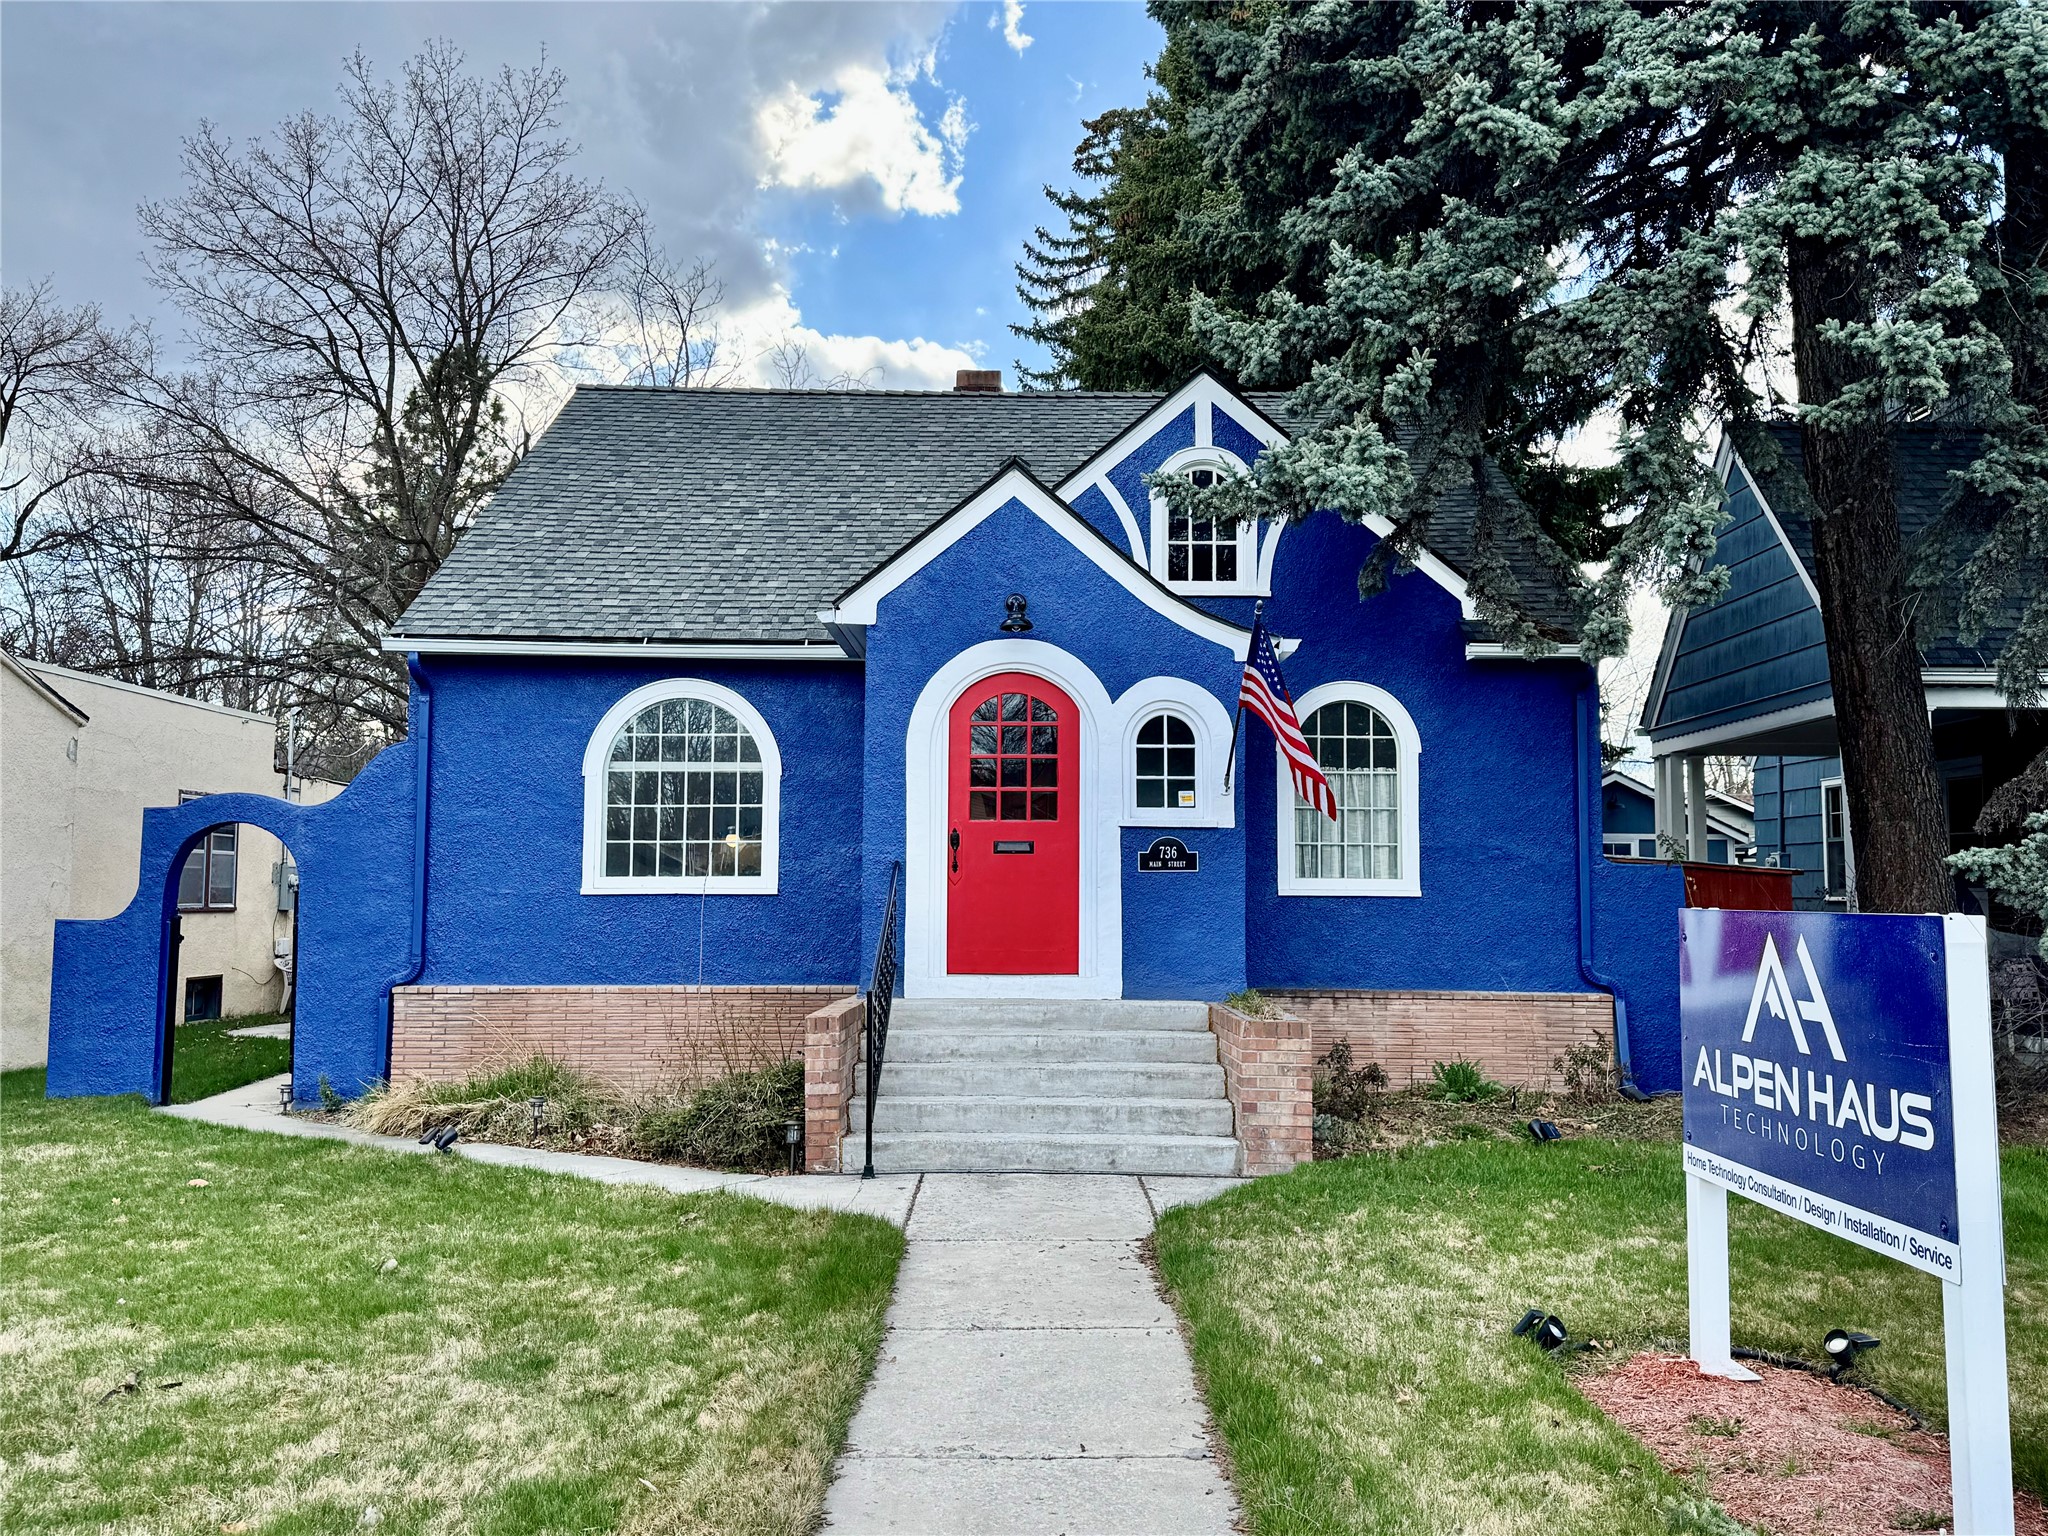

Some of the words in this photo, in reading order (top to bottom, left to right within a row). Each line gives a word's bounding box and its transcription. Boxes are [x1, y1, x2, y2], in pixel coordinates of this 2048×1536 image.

[1159, 846, 1177, 859] 736
[1692, 1045, 1800, 1117] ALPEN
[1807, 1070, 1935, 1151] HAUS
[1720, 1104, 1886, 1175] TECHNOLOGY
[1686, 1150, 1707, 1171] Home
[1707, 1158, 1747, 1191] Technology
[1747, 1175, 1798, 1209] Consultation
[1804, 1197, 1836, 1225] Design
[1844, 1212, 1900, 1250] Installation
[1909, 1236, 1953, 1270] Service
